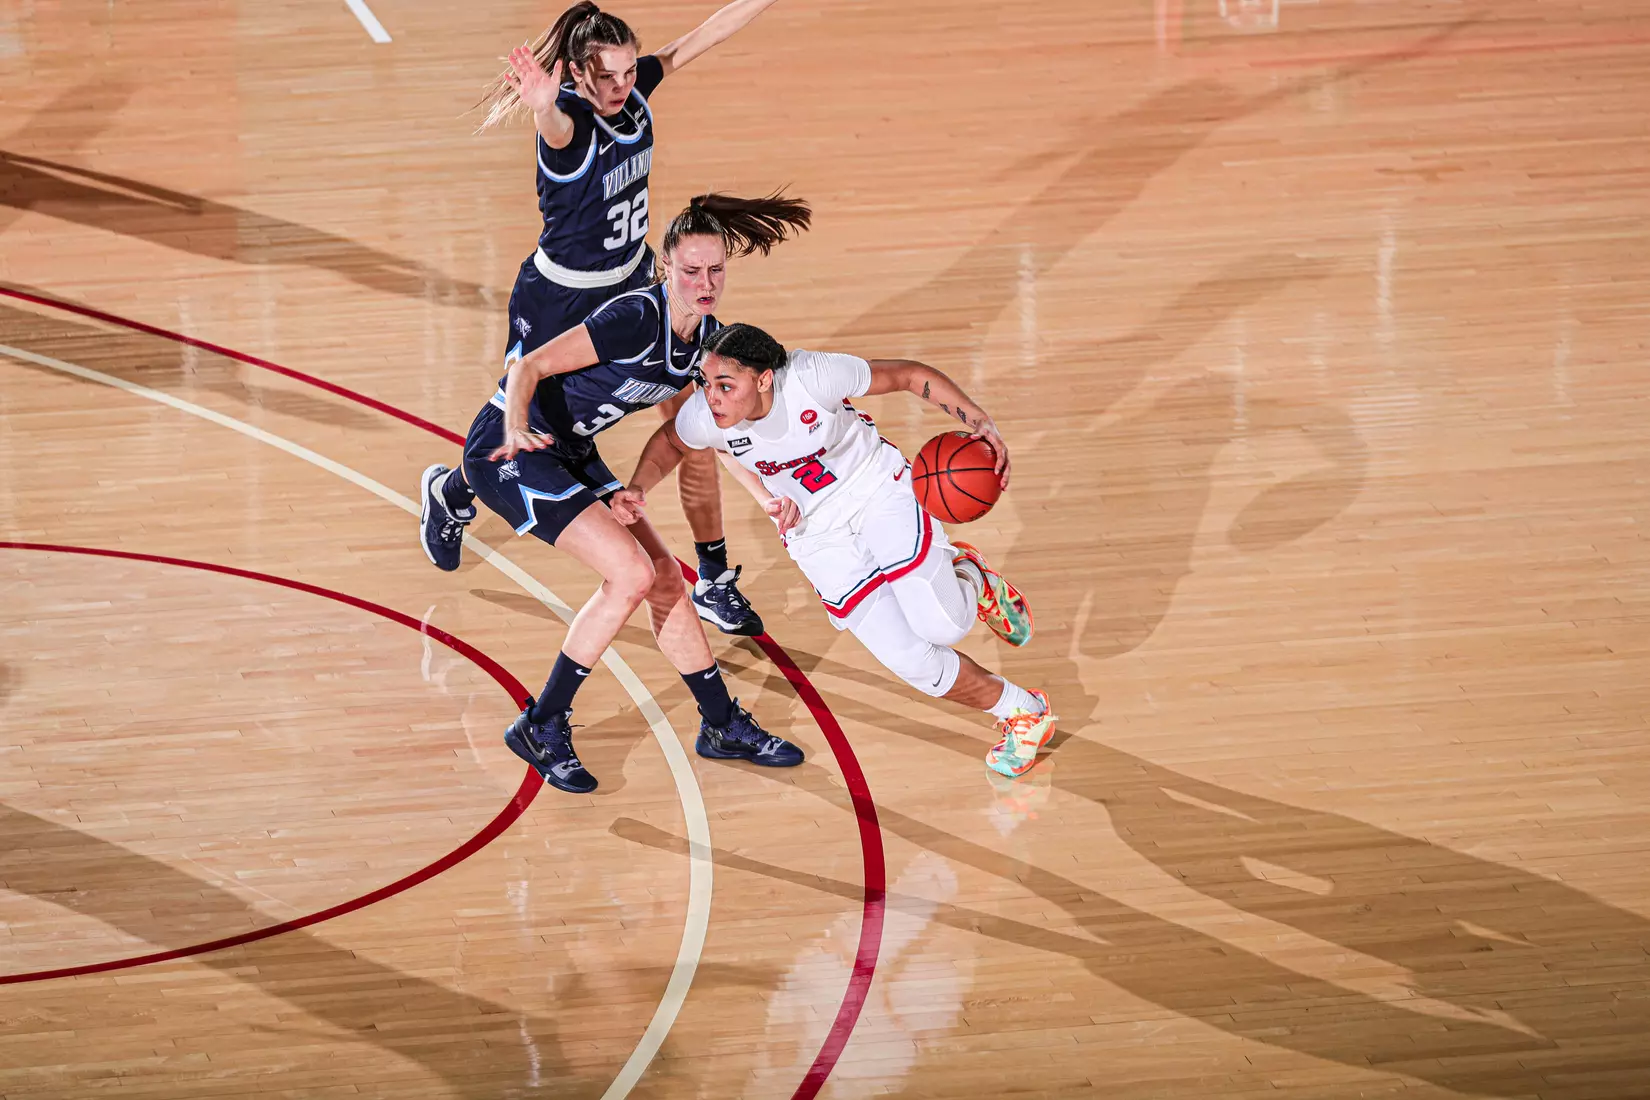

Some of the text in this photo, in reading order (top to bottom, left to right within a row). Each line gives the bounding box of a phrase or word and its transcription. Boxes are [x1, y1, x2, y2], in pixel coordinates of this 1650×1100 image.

[603, 187, 649, 251] 32
[572, 403, 625, 436] 3
[791, 459, 838, 494] 2
